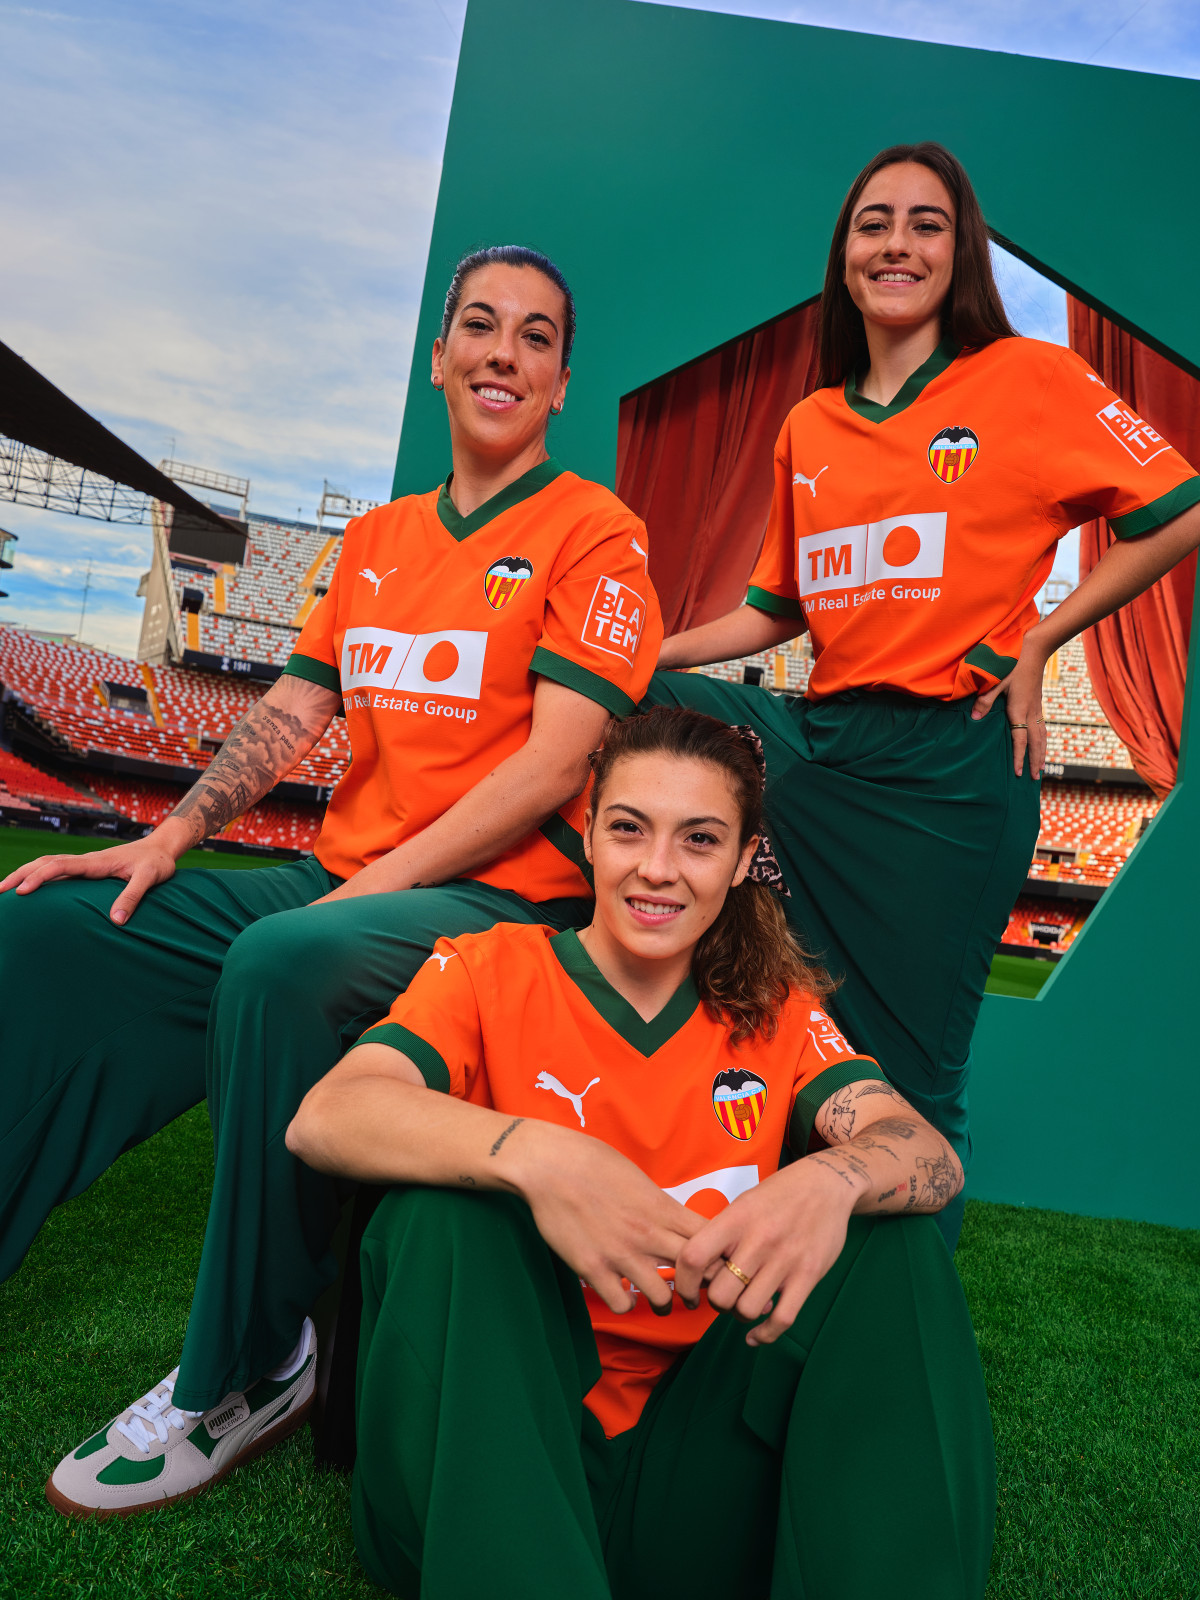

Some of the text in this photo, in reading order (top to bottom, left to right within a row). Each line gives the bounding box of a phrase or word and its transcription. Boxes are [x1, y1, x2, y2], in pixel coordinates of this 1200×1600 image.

[808, 544, 852, 581] TM
[819, 594, 848, 611] Real
[853, 588, 886, 607] Estate
[891, 585, 941, 602] Group
[595, 615, 638, 654] TEM
[348, 643, 393, 676] TM
[373, 694, 419, 713] Estate
[424, 700, 477, 723] Group
[262, 715, 281, 735] senza
[715, 1091, 749, 1101] VALENCIA
[208, 1407, 236, 1431] PUMA
[217, 1413, 244, 1434] PALERMO
